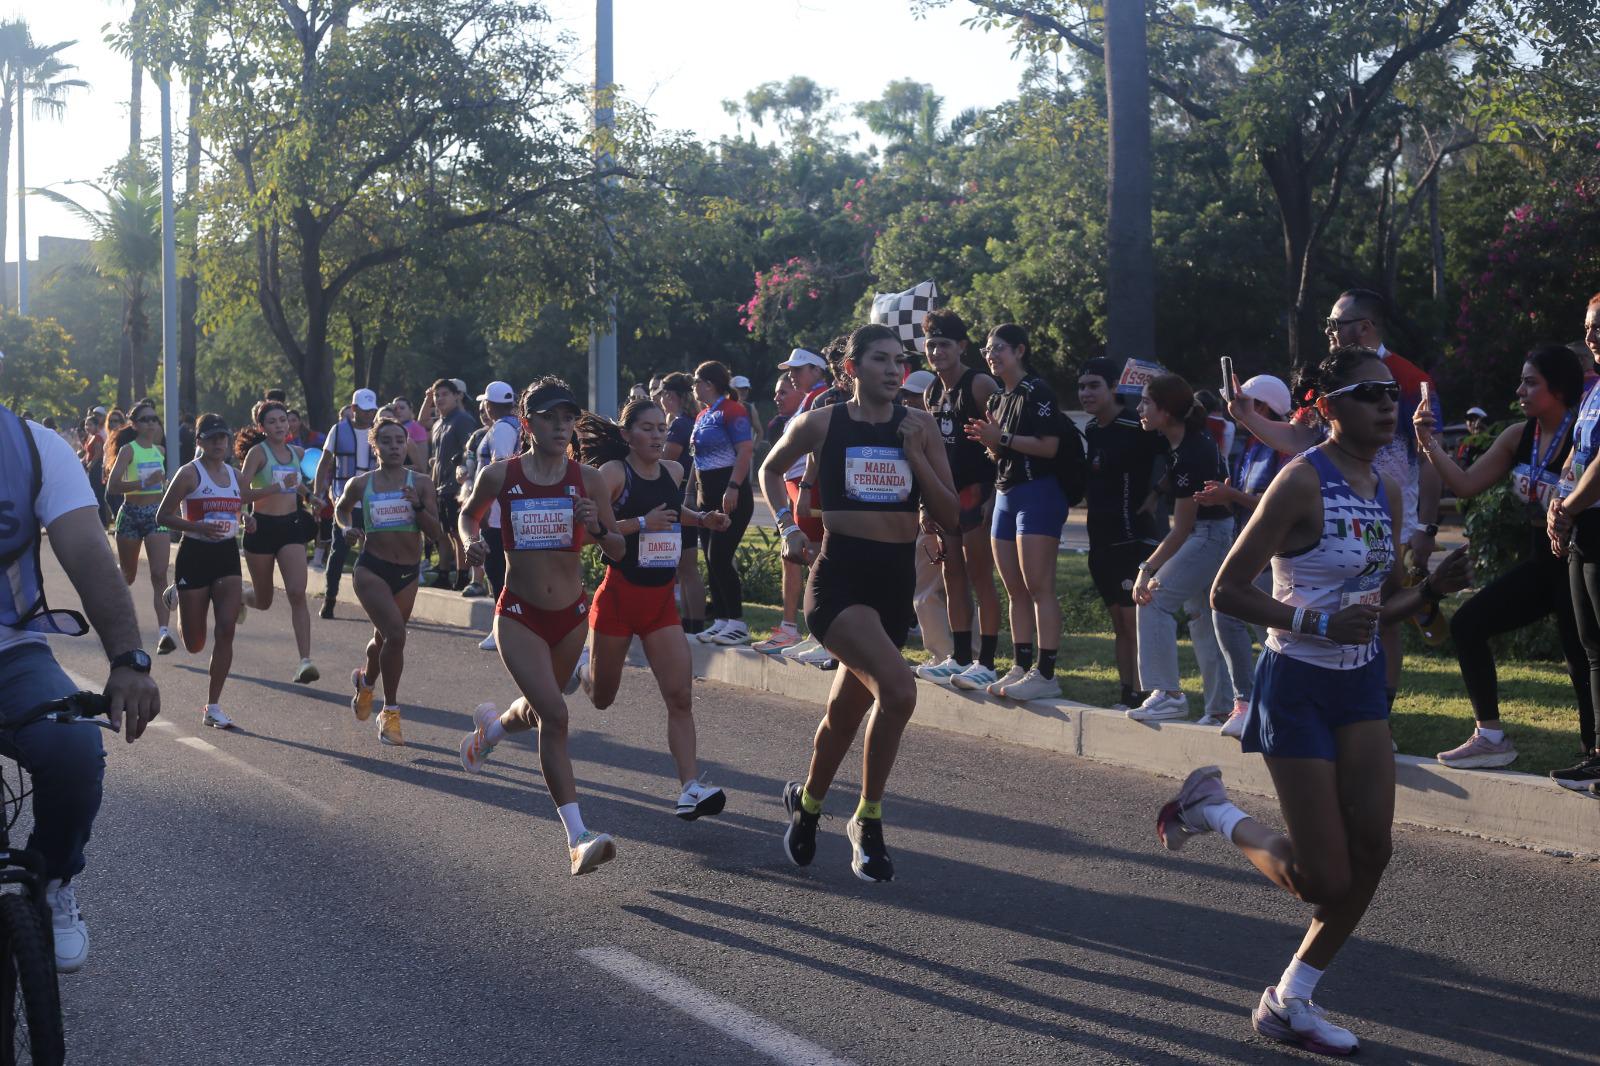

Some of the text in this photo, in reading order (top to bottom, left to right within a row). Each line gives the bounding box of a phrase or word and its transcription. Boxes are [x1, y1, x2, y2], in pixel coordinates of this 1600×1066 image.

[854, 474, 906, 487] FERNANDA
[523, 512, 564, 524] CITLALIC
[520, 523, 568, 536] JAQUELINE
[648, 541, 677, 552] DANIELA
